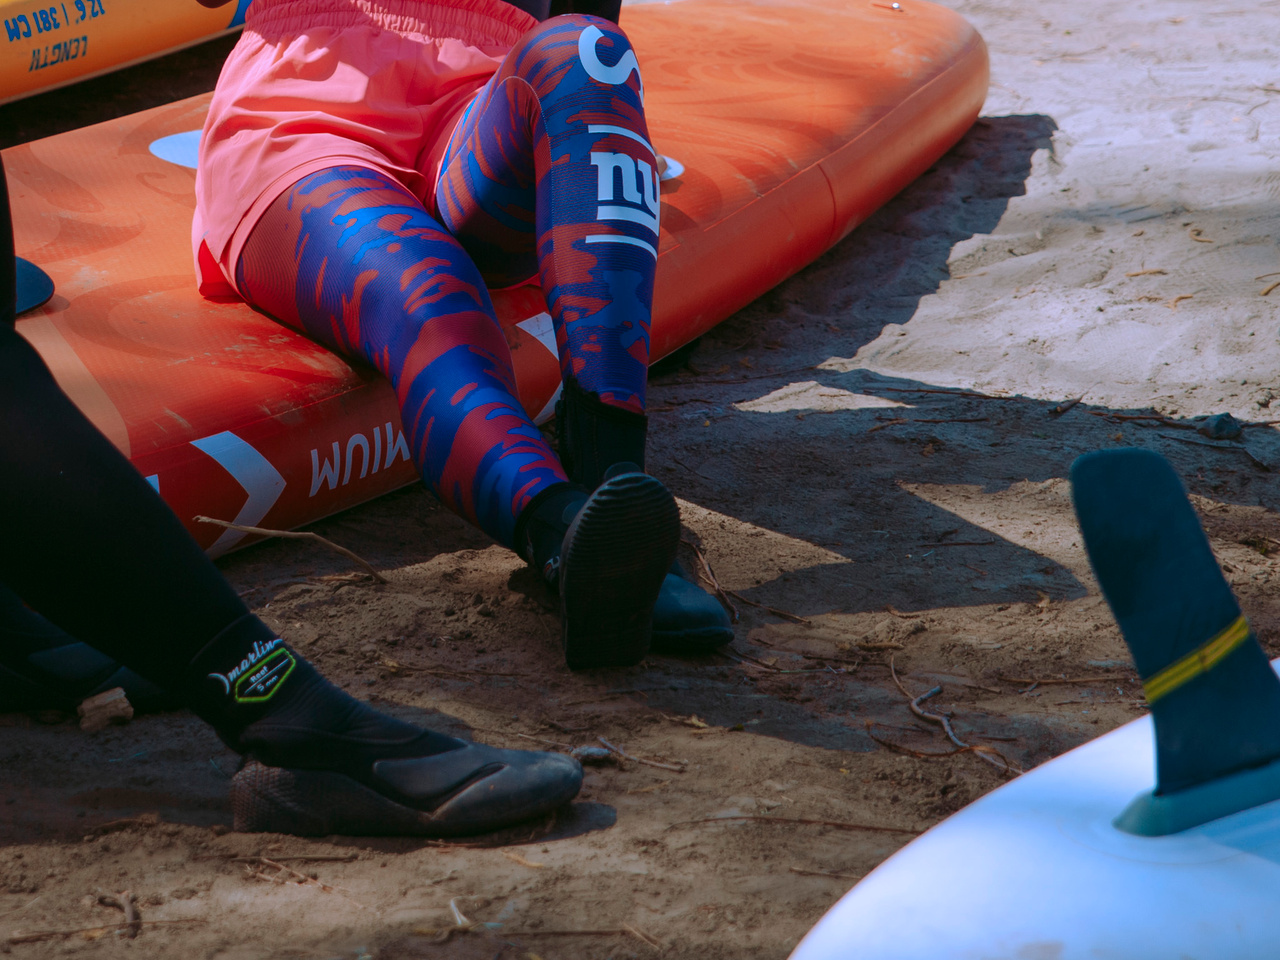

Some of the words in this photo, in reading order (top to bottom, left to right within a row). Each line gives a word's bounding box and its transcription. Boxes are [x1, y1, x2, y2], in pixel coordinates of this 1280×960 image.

[4, 14, 32, 42] CM
[32, 6, 61, 34] 381
[28, 35, 88, 72] LENGTH
[226, 638, 283, 682] marlin
